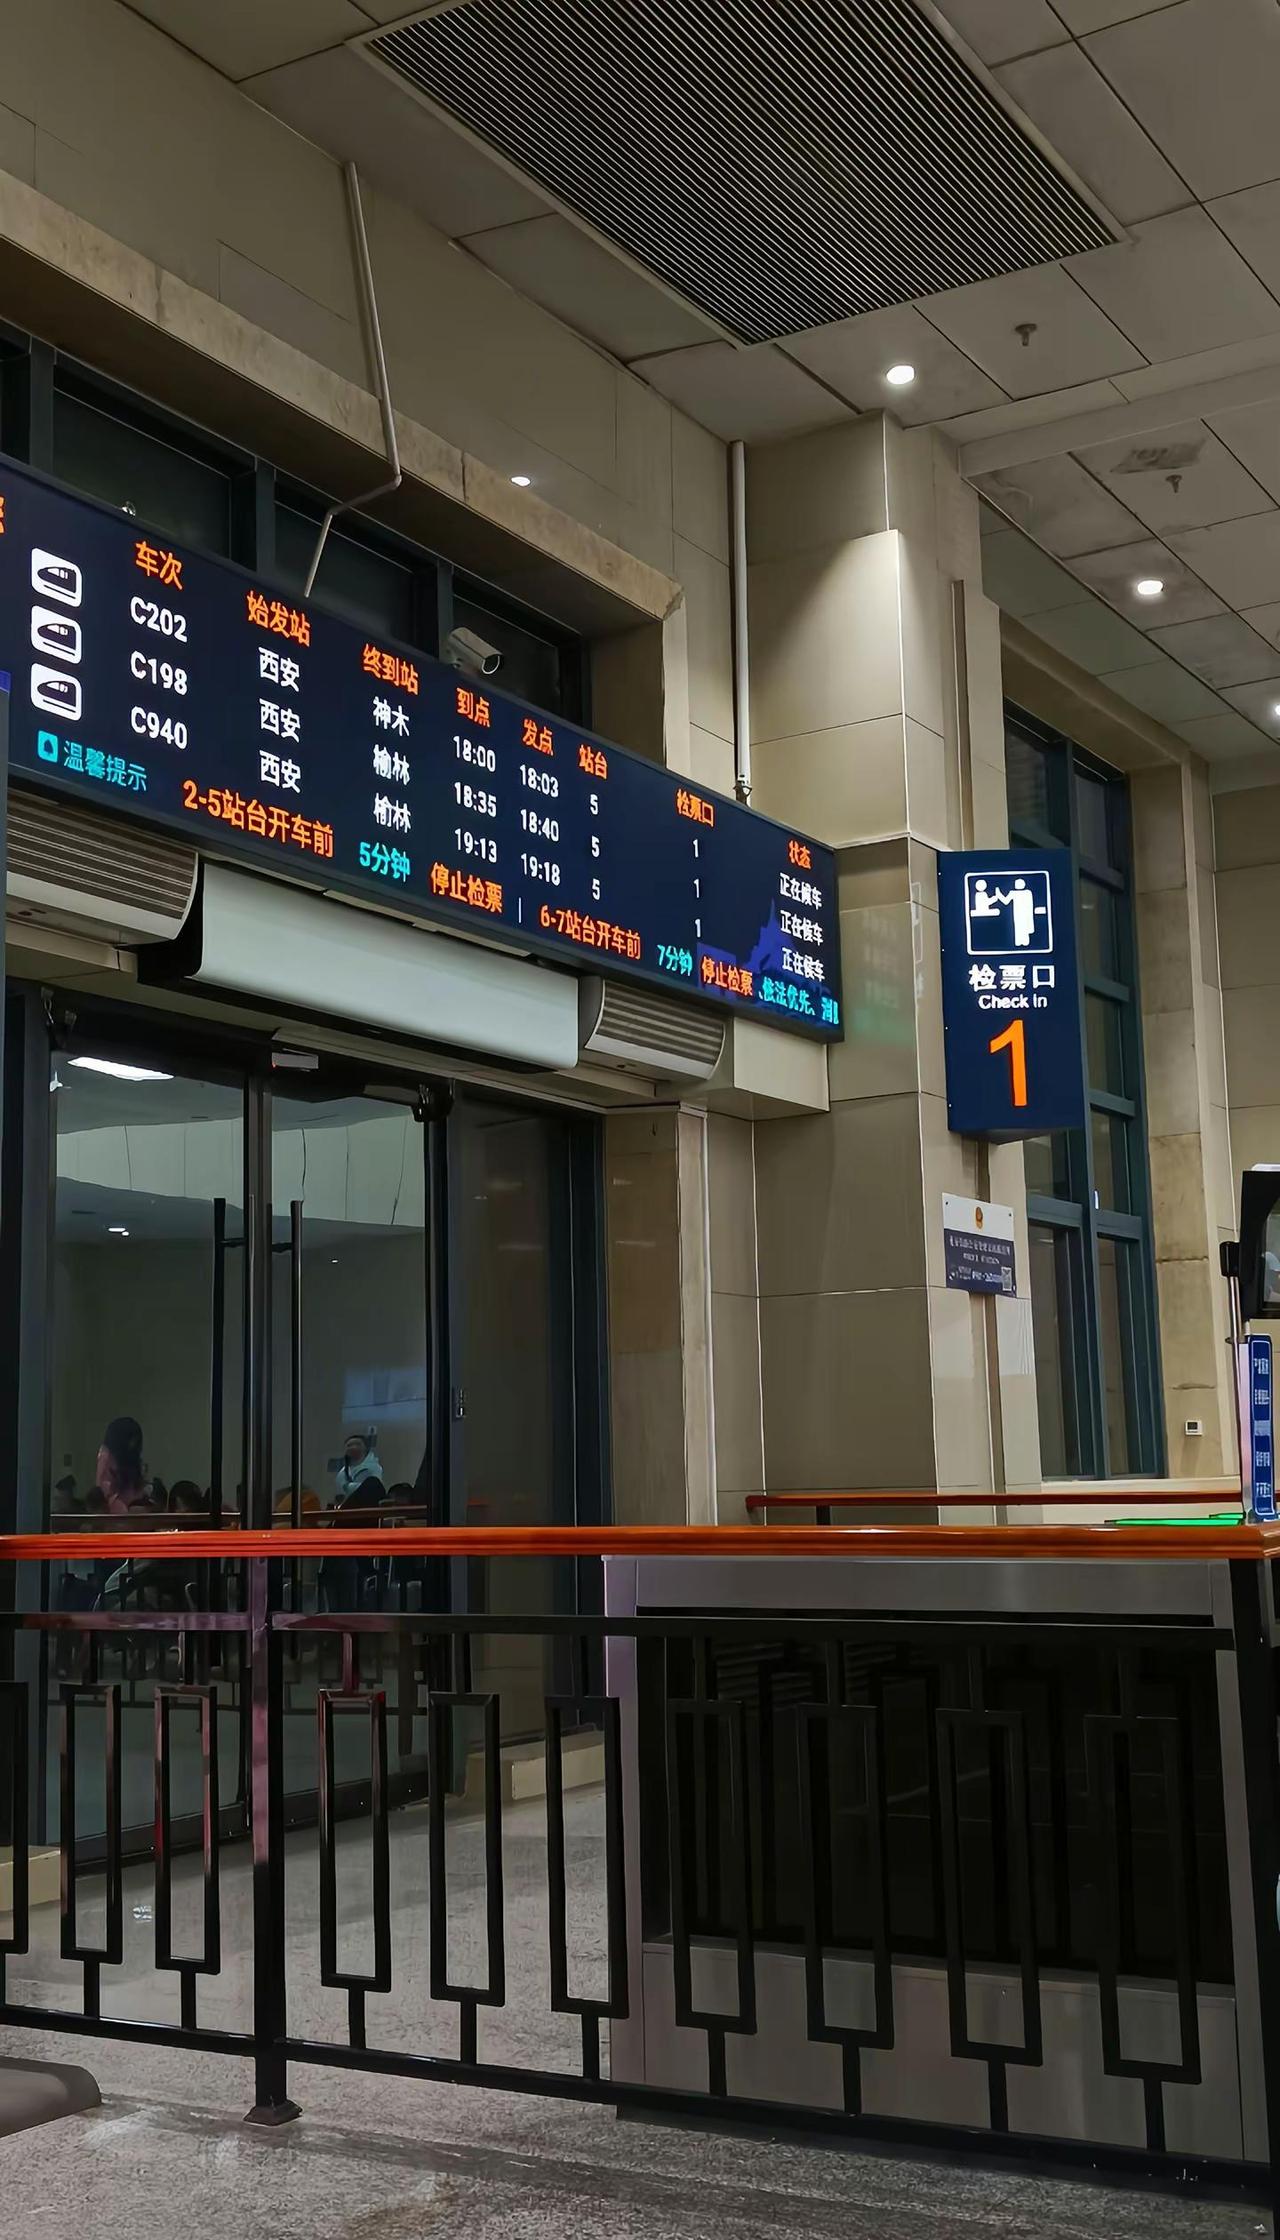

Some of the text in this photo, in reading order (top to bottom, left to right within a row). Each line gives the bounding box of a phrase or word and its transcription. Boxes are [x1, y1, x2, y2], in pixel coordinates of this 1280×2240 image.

[130, 596, 823, 910] C202 西安 神木 18:00 18:03 5 1 正在候车
[130, 650, 824, 947] C198 西安 榆林 18:35 18:40 5 1 正在候车
[135, 541, 811, 869] 车次 始发站 终到站 到点 发点 站台 检票口 状态
[63, 740, 148, 793] 温馨提示
[182, 779, 335, 859] 2-5站台开车前
[359, 841, 411, 883] 5分钟
[430, 862, 503, 914] 停止检票
[539, 905, 642, 961] 6-7站台开车前
[656, 943, 693, 977] 7分钟
[701, 956, 754, 996] 停止检票
[130, 705, 826, 982] C940 西安 榆林 19:13 19:18 5 1 正在候车
[968, 963, 1056, 993] 检票口
[978, 994, 1030, 1010] Check
[989, 1019, 1028, 1107] 1
